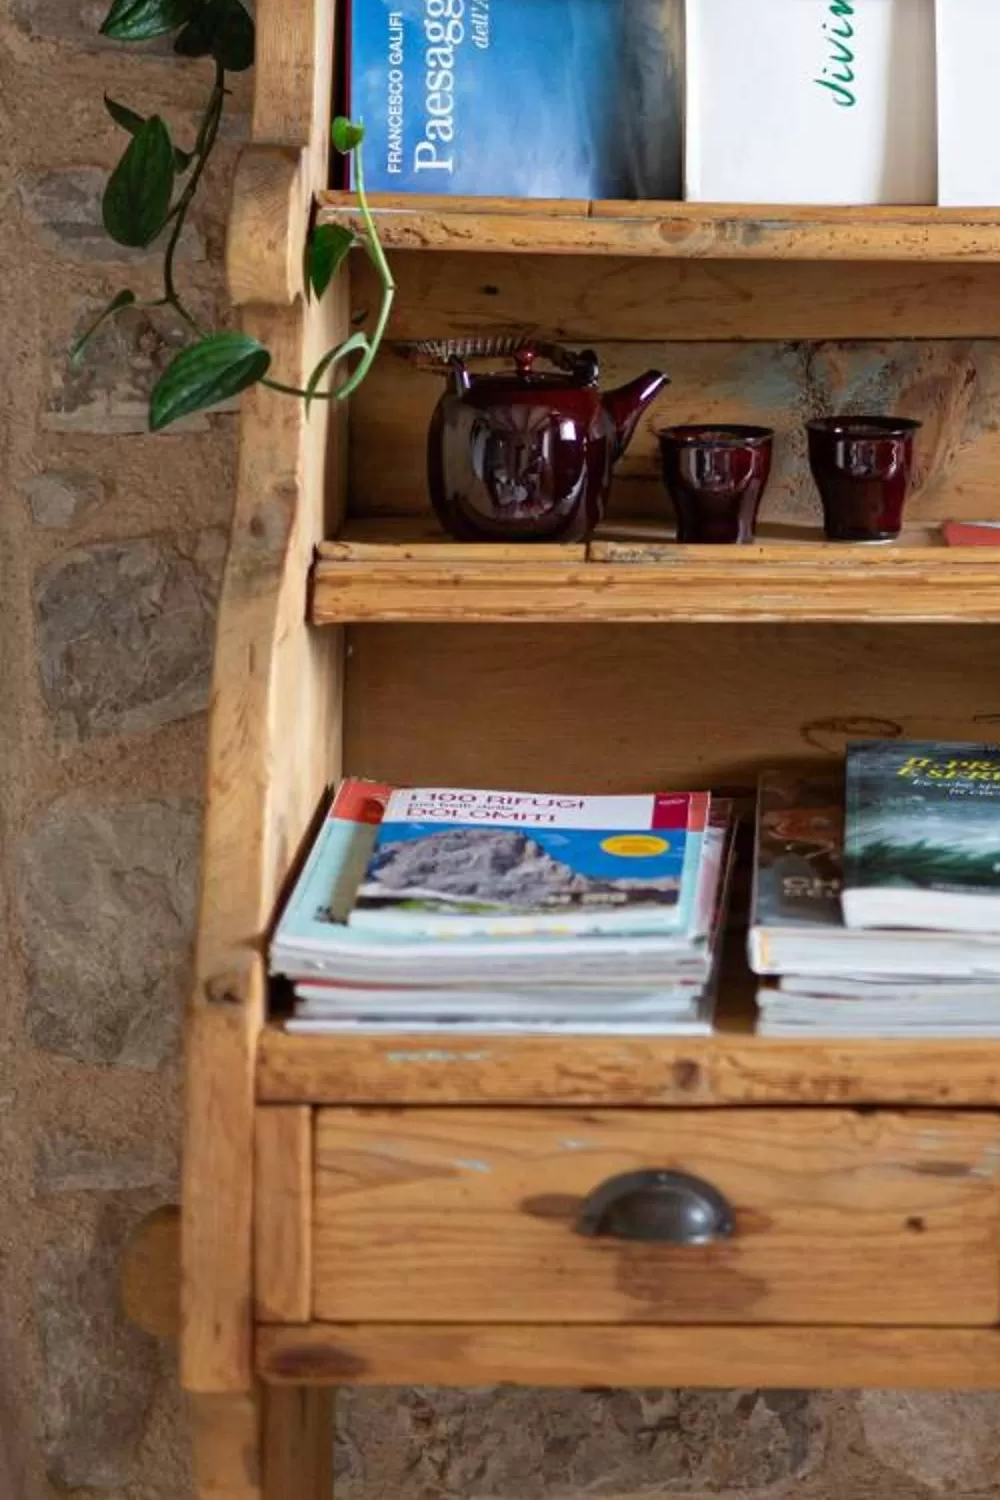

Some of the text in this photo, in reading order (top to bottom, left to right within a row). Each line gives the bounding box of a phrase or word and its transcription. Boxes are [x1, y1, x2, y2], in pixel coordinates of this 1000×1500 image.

[387, 11, 403, 174] FRANCESCO GALIFI
[487, 794, 585, 809] RIFUGI
[406, 807, 555, 822] DOLOMITI
